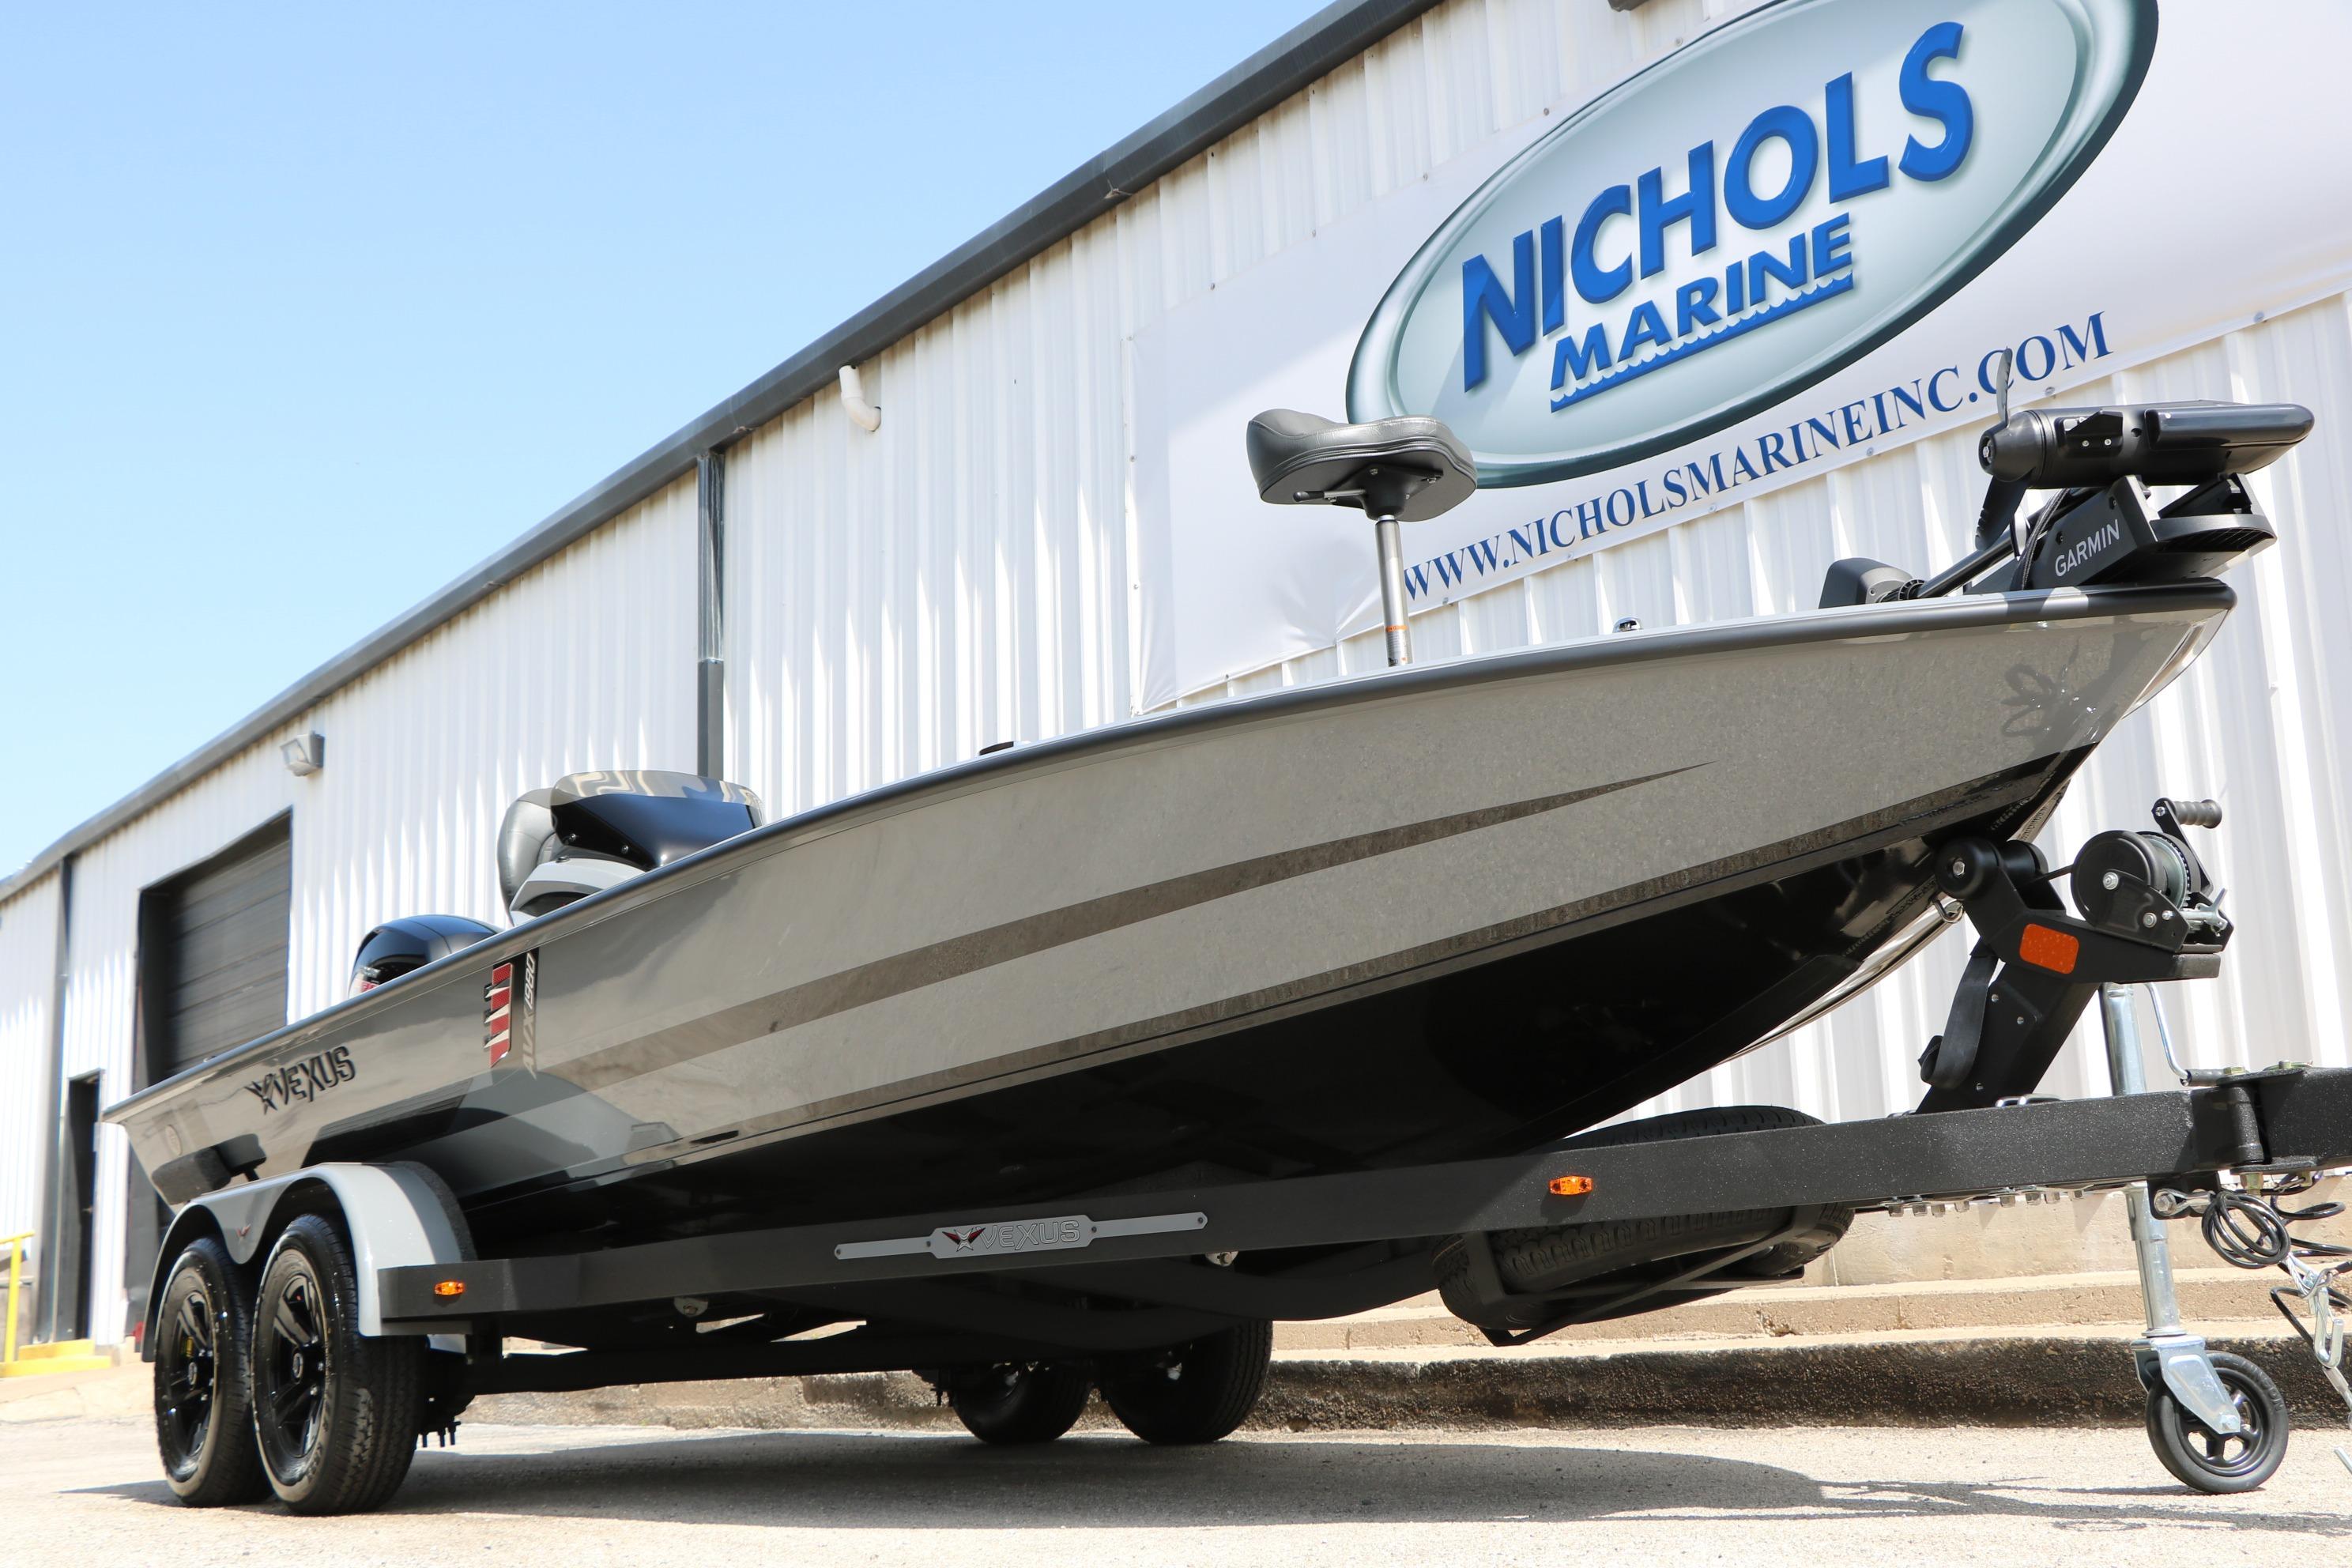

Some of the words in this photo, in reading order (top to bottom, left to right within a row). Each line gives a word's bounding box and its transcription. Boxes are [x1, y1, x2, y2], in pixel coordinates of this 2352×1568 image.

[1462, 21, 1974, 393] NICHOLS
[1551, 213, 1853, 391] MARINE
[1404, 311, 2113, 601] WWW.NICHOLSMARINEINC.COM
[2055, 518, 2120, 577] GARMIN
[977, 1220, 1080, 1250] VEXUS
